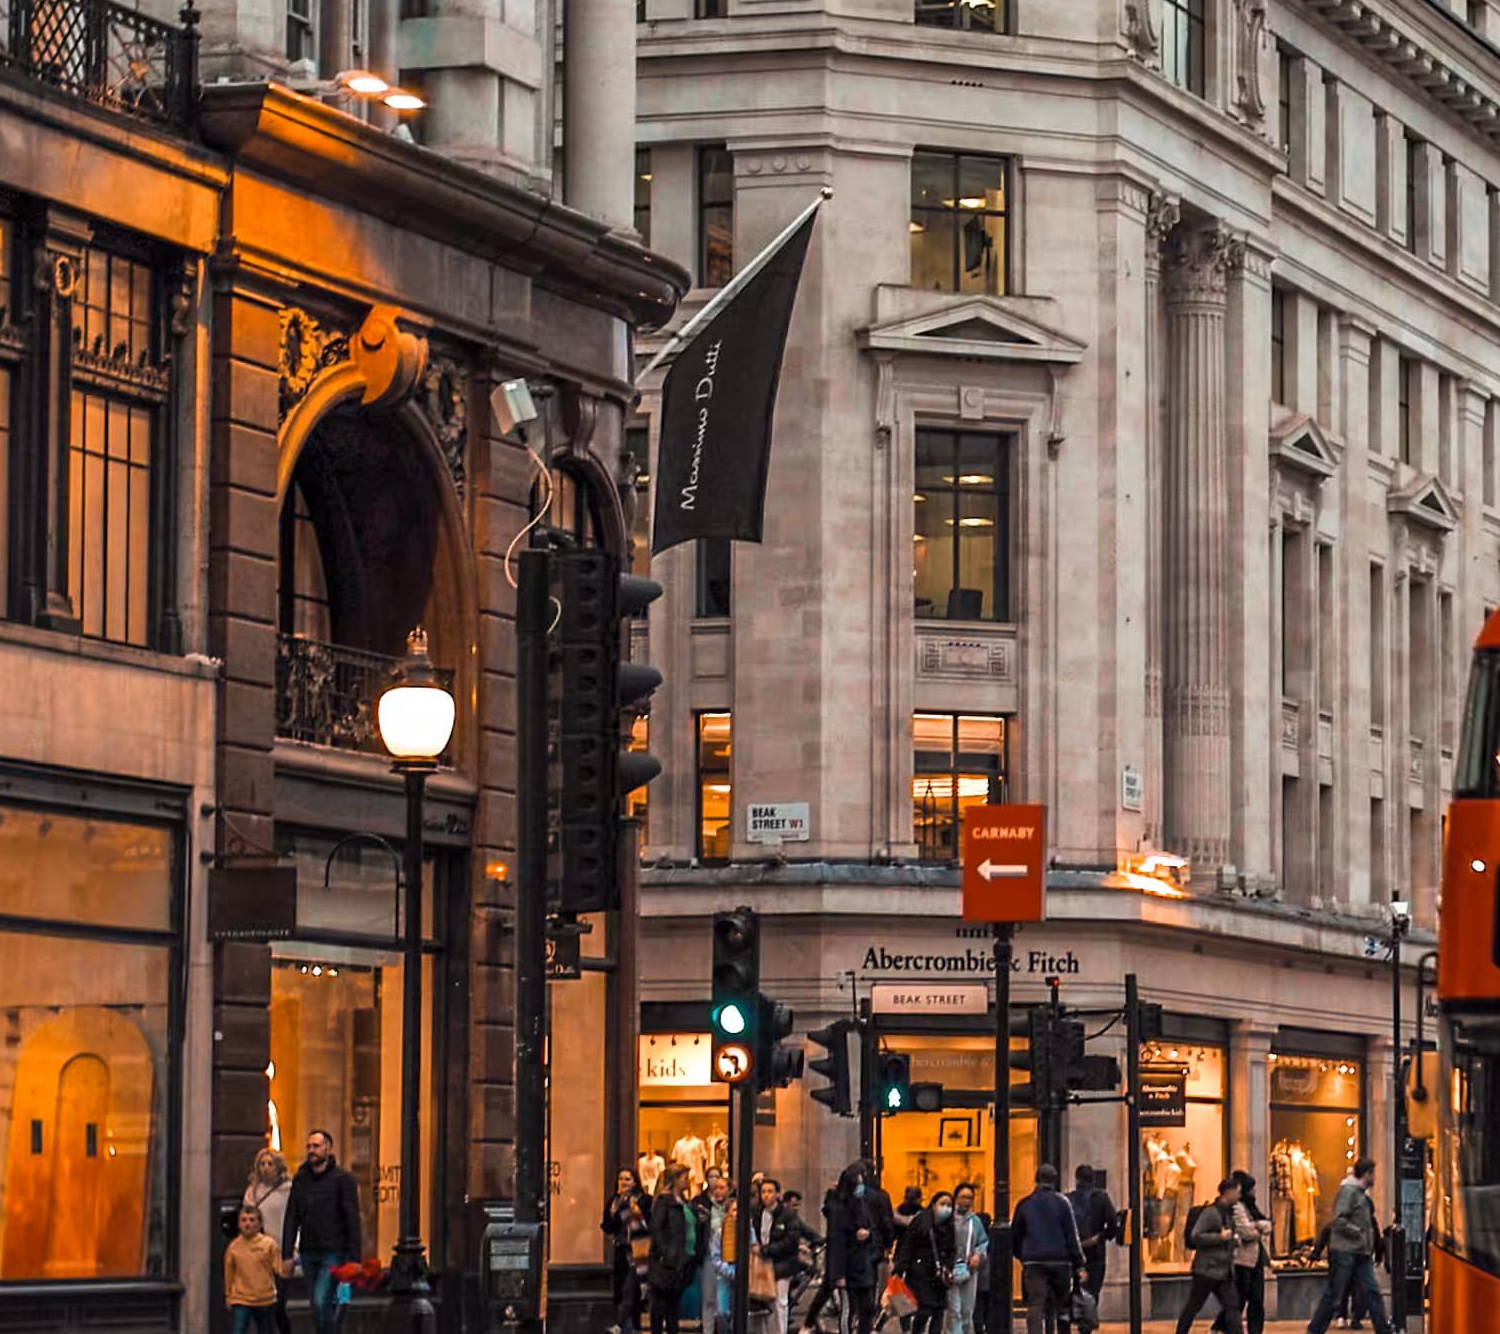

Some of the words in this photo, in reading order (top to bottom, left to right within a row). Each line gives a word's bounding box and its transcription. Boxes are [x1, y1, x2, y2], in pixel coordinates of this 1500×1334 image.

[680, 408, 708, 510] Massimo
[695, 339, 722, 403] Dutti
[752, 807, 777, 818] BEAK
[752, 819, 787, 829] STREET
[972, 827, 1035, 840] CARNABY
[862, 947, 997, 972] Abercrombie
[1027, 951, 1079, 973] Fitch
[893, 994, 922, 1005] BEAK
[925, 994, 967, 1005] STREET
[646, 1057, 687, 1078] kids
[913, 1053, 977, 1068] bercrombie
